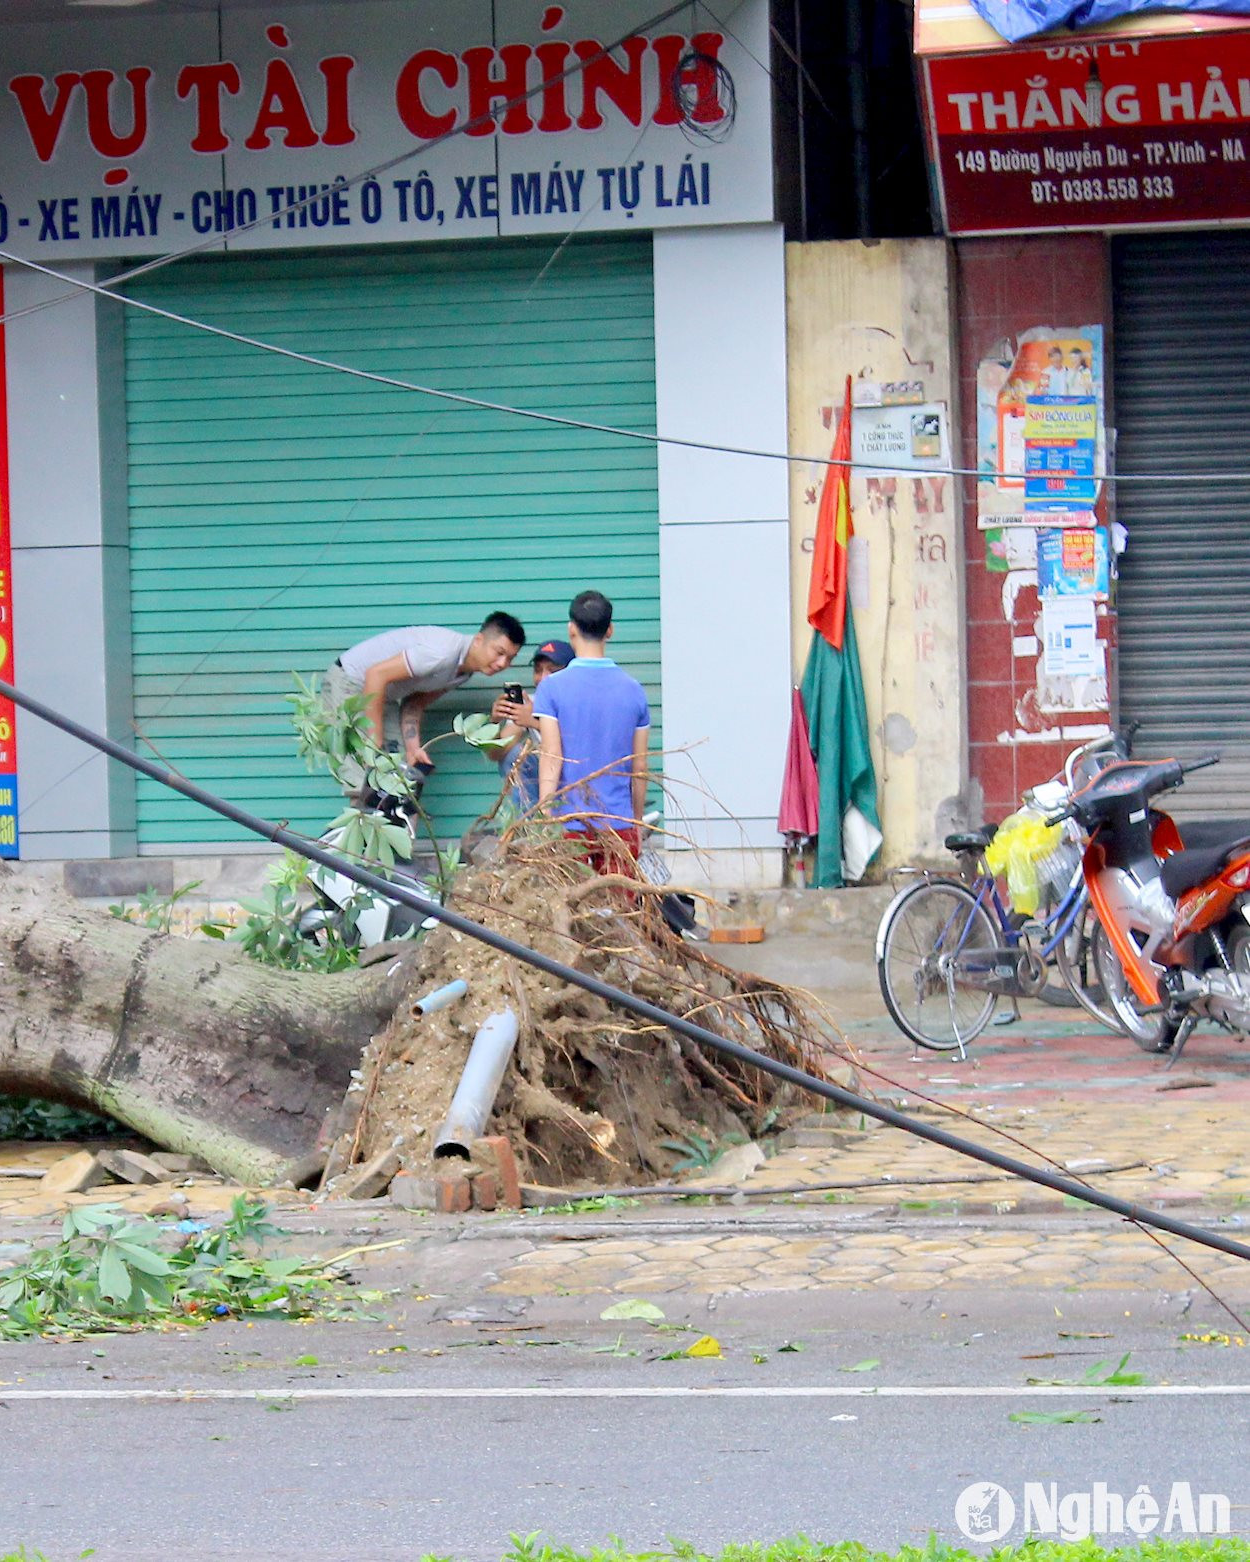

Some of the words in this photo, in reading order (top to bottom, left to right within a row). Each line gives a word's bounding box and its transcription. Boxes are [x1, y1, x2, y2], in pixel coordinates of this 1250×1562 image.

[9, 67, 152, 186] VỤ
[177, 23, 357, 152] TÀI
[396, 7, 726, 140] CHÍNH
[955, 149, 987, 173] 149
[989, 148, 1041, 175] Đường
[1043, 141, 1103, 174] Nguyễn
[1105, 143, 1129, 167] Du
[1221, 138, 1246, 162] NA
[38, 198, 81, 242] XE
[91, 186, 163, 239] MÁY
[192, 187, 258, 234] CHO
[266, 175, 351, 230] THUÊ
[361, 174, 382, 224] Ô
[393, 169, 445, 227] TÔ,
[455, 174, 499, 219] XE
[511, 161, 585, 216] MÁY
[597, 161, 645, 218] TỰ
[655, 153, 710, 208] LÁI
[1030, 179, 1059, 204] ĐT:
[1061, 176, 1139, 201] 0383.558
[1142, 175, 1175, 200] 333
